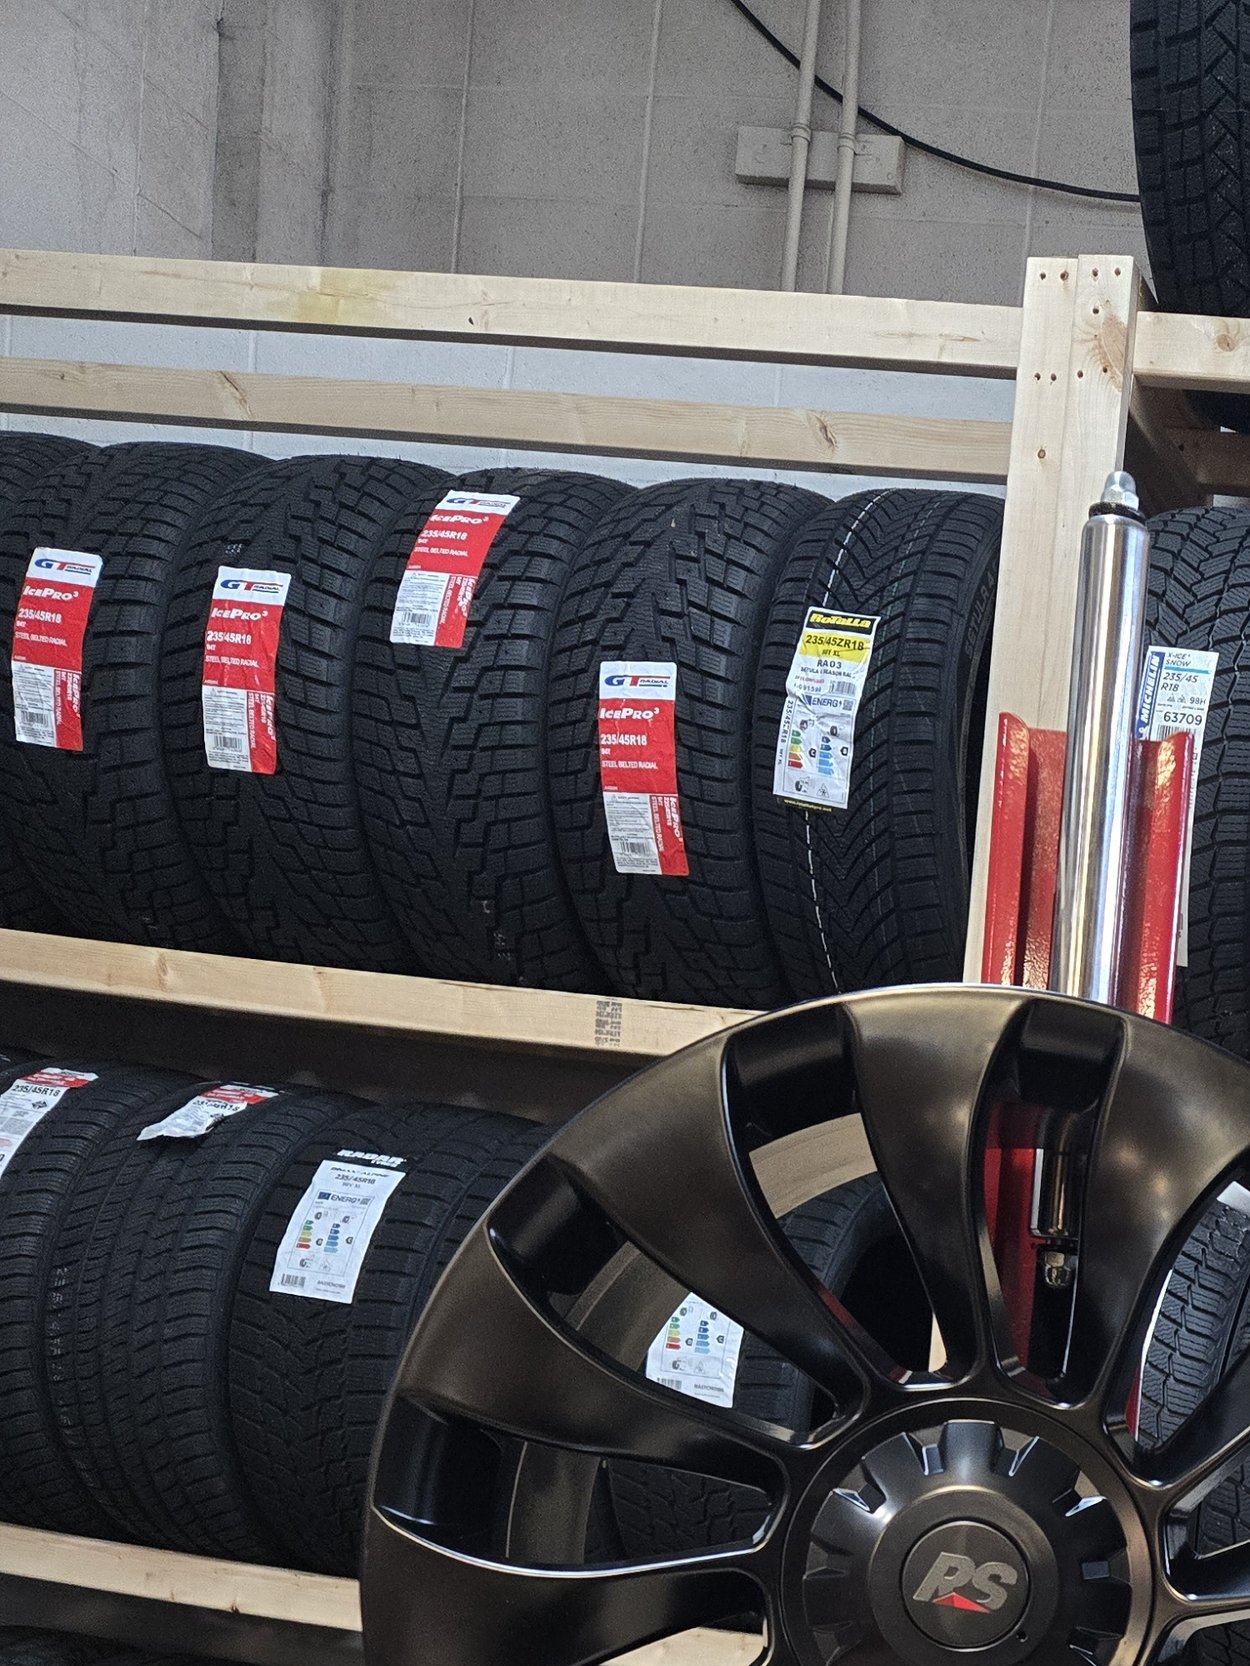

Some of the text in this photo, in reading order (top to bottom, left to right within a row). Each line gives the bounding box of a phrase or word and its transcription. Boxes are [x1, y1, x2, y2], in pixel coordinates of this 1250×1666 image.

[422, 530, 468, 540] 235/45R18
[18, 608, 62, 624] 235/45R18
[207, 631, 251, 645] 235/45R18
[805, 634, 865, 652] 235/45ZR18
[817, 659, 842, 669] RA03
[1166, 659, 1191, 667] SNOW
[1162, 672, 1199, 683] 235/45
[1140, 655, 1160, 724] MICHELIN
[1161, 682, 1180, 692] R18
[1190, 697, 1207, 705] 98H
[1163, 711, 1203, 726] 63709
[601, 734, 647, 746] 235/45R18
[337, 1149, 404, 1164] RADAR
[913, 1551, 1018, 1610] RS
